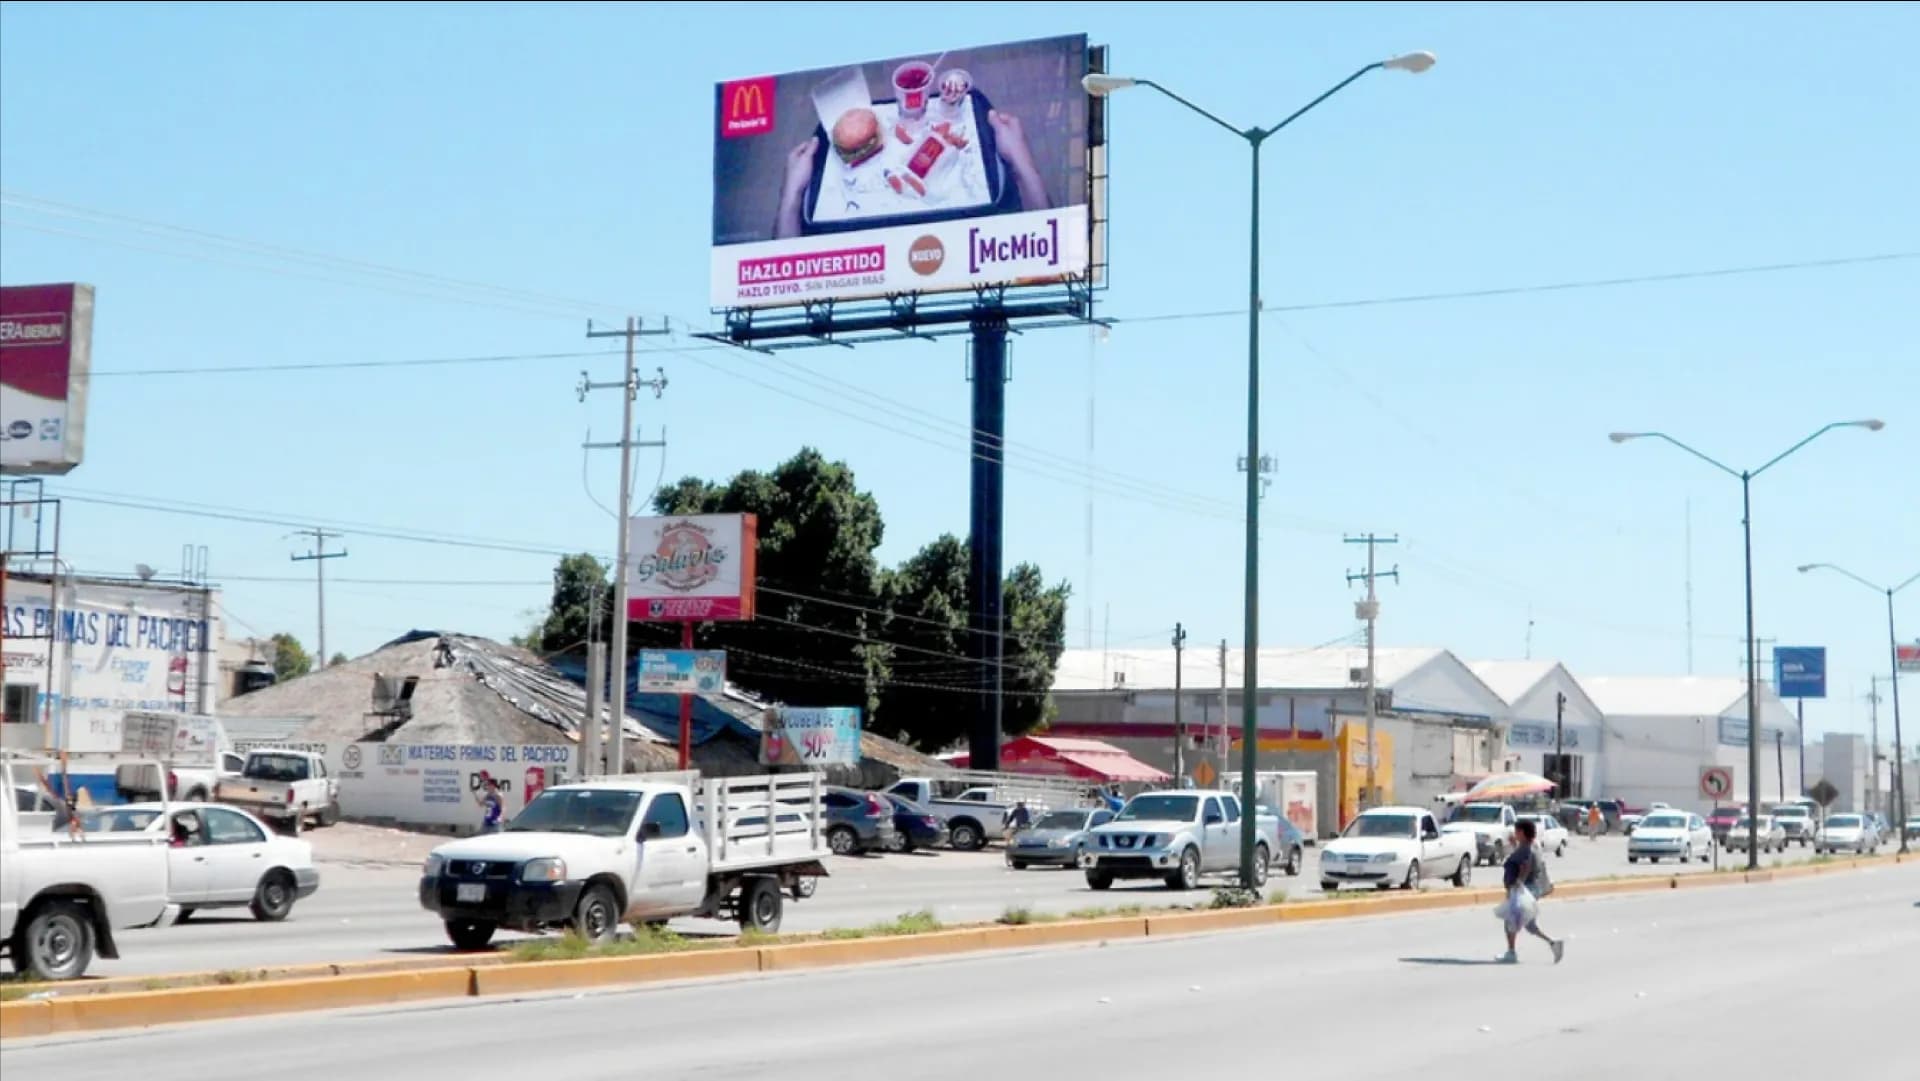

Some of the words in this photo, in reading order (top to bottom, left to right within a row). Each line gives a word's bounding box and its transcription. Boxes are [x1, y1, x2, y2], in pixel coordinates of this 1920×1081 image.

[911, 249, 942, 262] NUEVO
[741, 263, 793, 282] HAZLO
[795, 252, 881, 277] DIVERTIDO
[737, 284, 771, 298] HAZLO
[106, 613, 130, 648] DEL
[137, 615, 209, 653] PACIFICO
[408, 745, 457, 761] MATERIAS
[460, 745, 497, 762] PRIMAS
[501, 746, 518, 763] DEL
[522, 746, 570, 763] PACIFICO
